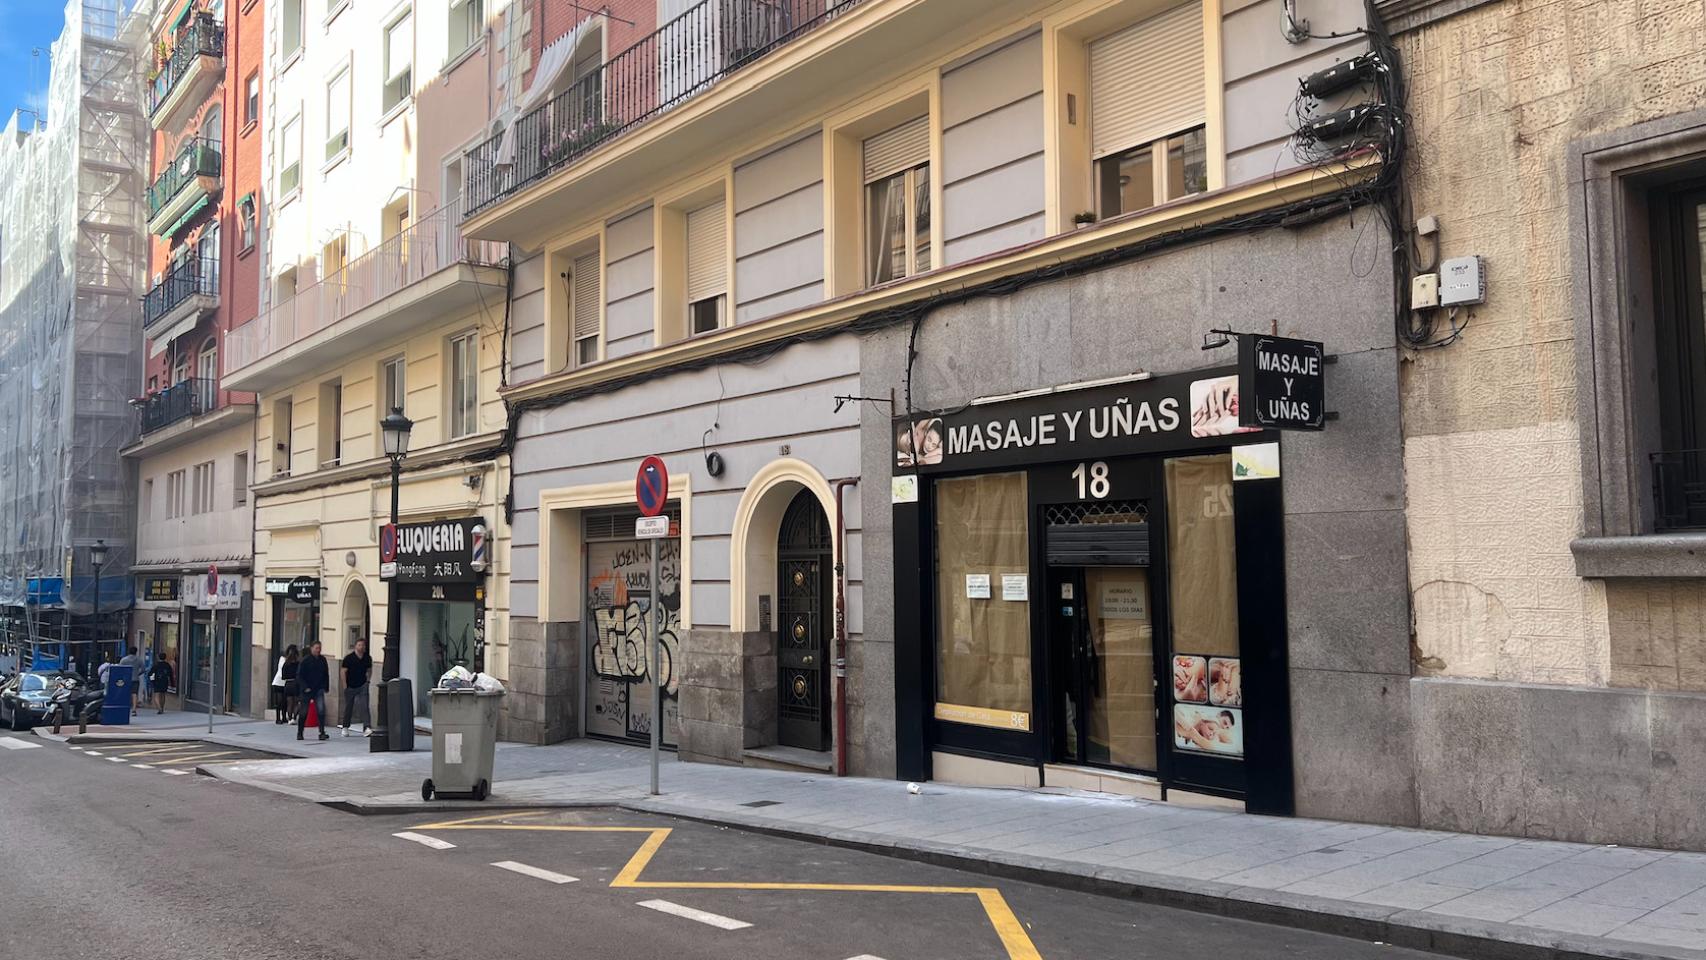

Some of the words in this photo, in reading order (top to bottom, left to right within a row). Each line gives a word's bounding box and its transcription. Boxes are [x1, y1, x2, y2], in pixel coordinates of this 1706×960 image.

[1258, 351, 1318, 376] MASAJE
[1283, 377, 1294, 396] Y
[1269, 397, 1310, 420] UÑAS
[948, 414, 1056, 454] MASAJE
[1062, 410, 1082, 441] Y
[1089, 397, 1180, 438] UÑAS
[1072, 461, 1110, 499] 18
[397, 523, 464, 556] LUQUERIA
